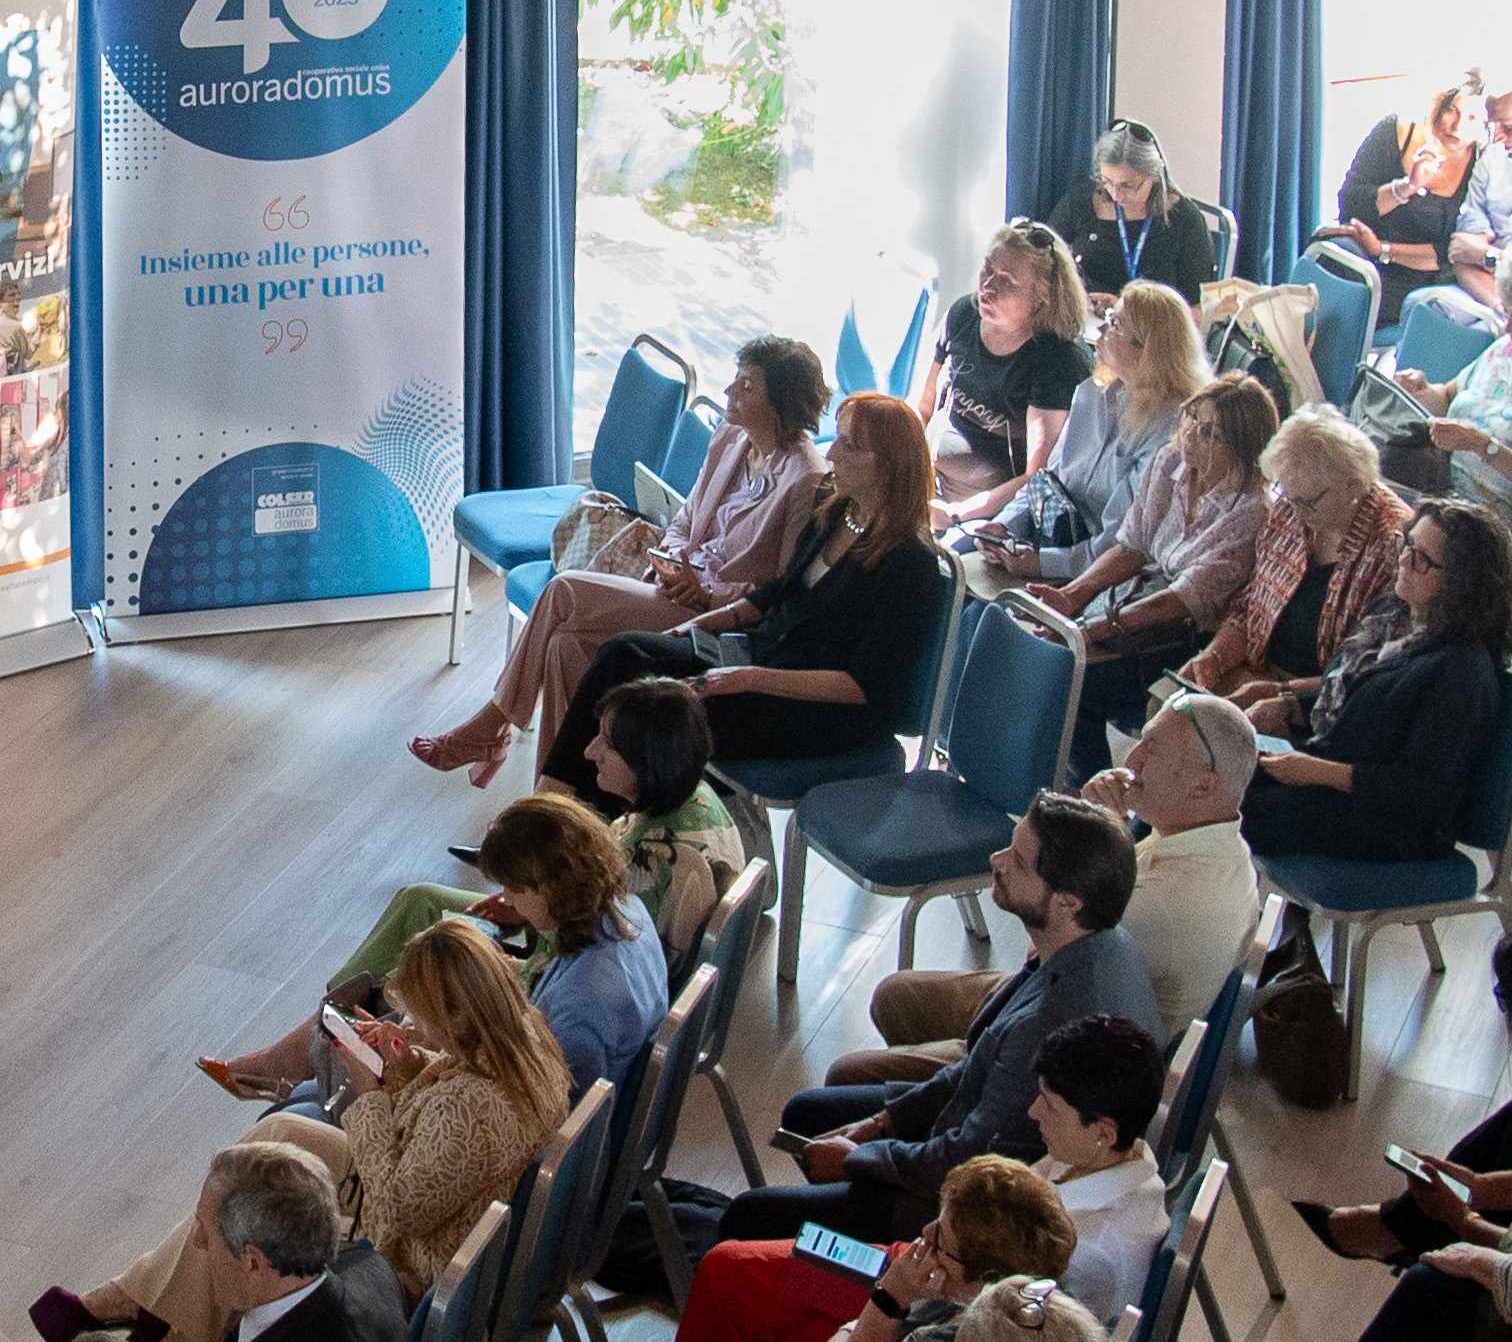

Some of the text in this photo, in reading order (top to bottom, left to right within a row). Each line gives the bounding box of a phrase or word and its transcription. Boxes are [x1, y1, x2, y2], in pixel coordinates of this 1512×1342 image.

[179, 70, 391, 107] auroradomus
[139, 237, 431, 276] Insieme alle persone,
[184, 272, 385, 311] una per una
